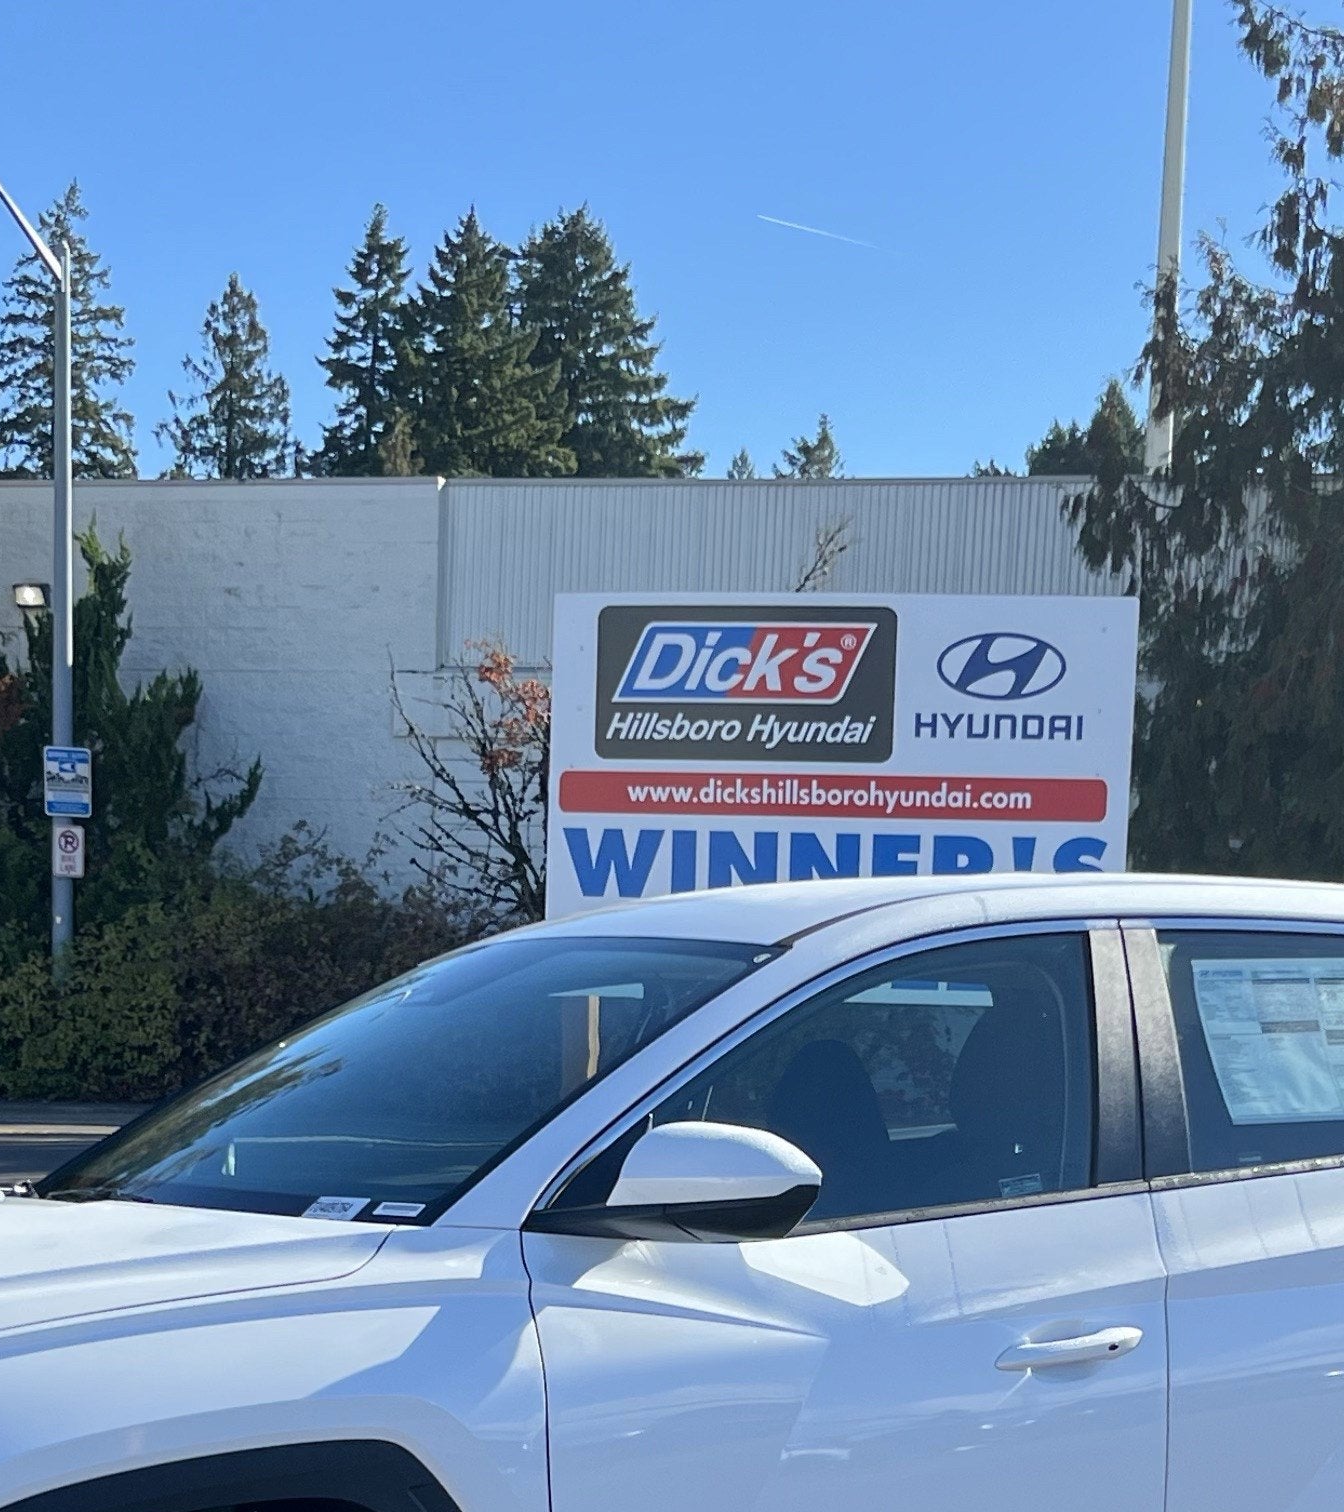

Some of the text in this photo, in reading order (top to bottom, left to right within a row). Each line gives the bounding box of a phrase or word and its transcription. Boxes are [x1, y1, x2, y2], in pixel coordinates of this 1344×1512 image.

[632, 631, 843, 693] Dick's
[605, 712, 877, 749] Hillsboro Hyundai
[915, 712, 1084, 741] HYUNDAI
[627, 779, 1032, 813] www.dickshillsborohyundai.com
